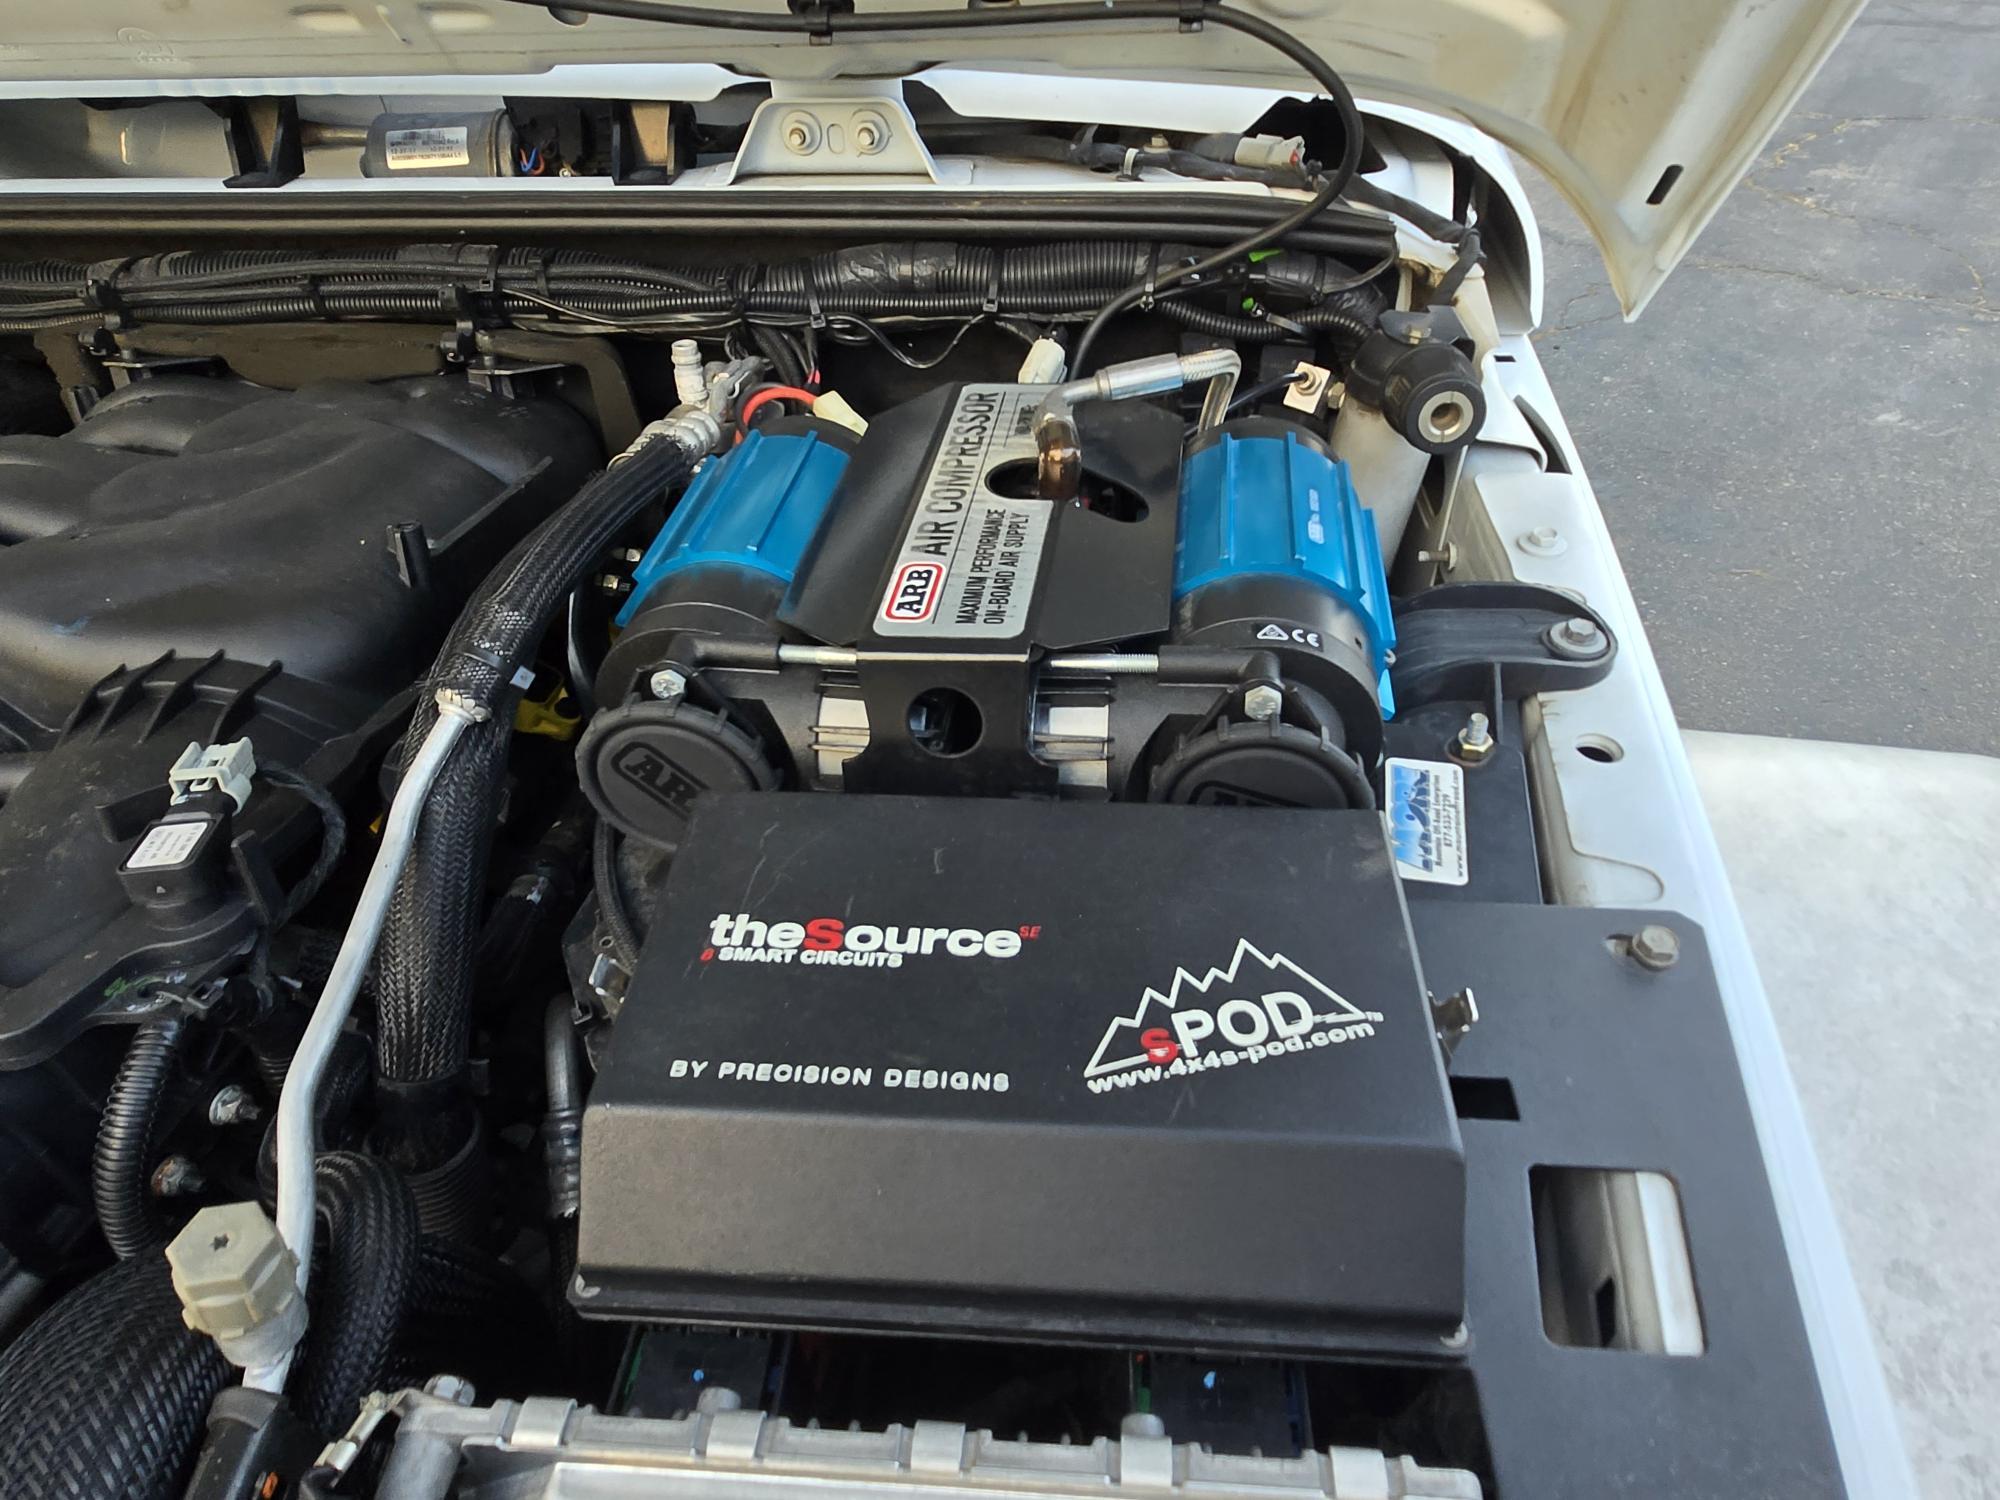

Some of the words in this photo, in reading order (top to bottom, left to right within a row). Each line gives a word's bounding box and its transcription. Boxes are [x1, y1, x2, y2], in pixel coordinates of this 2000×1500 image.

[925, 391, 999, 514] COMPRESSOR
[910, 520, 958, 557] AIR
[971, 508, 1006, 573] PERFORMANCE
[1006, 512, 1031, 548] SUPPLY
[998, 548, 1019, 569] AIR
[896, 568, 934, 614] ARB
[955, 575, 988, 624] MAXIMUM
[983, 570, 1016, 625] ON-BOARD
[1291, 628, 1320, 648] CE
[624, 754, 700, 814] AR
[710, 913, 1022, 958] theSource
[718, 946, 798, 964] SMART
[800, 949, 903, 968] CIRCUITS
[669, 1059, 709, 1079] BY
[718, 1061, 873, 1087] PRECISION
[884, 1067, 1010, 1093] DESIGNS
[1086, 1021, 1376, 1095] www.4x4s-pod.com
